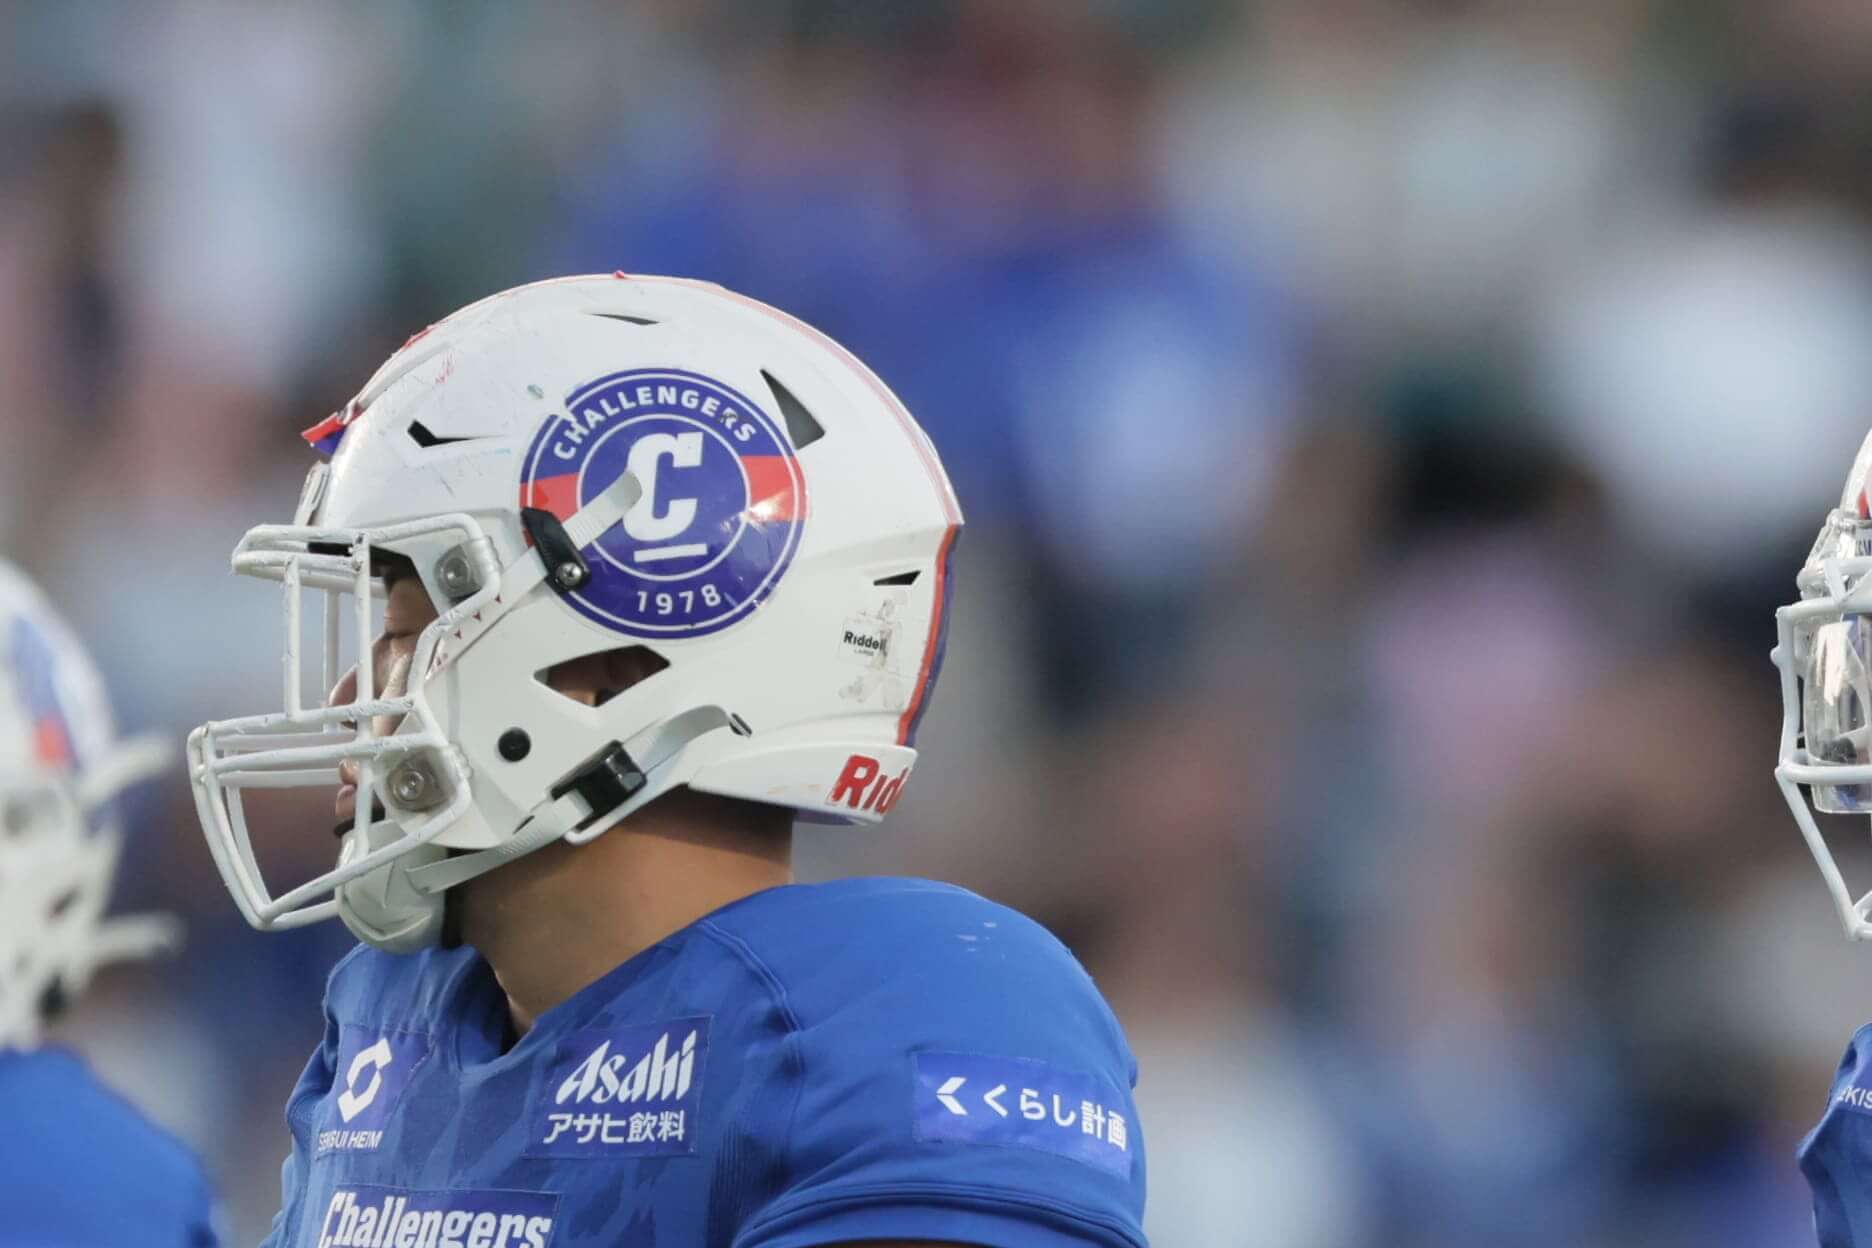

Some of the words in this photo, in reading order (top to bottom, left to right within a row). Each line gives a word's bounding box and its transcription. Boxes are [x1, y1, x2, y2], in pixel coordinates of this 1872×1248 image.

[553, 386, 757, 460] CHALLENGERS
[622, 431, 704, 541] C
[637, 584, 721, 615] 1978
[555, 1030, 697, 1105] Asahi
[347, 1130, 383, 1149] HEIM
[543, 1110, 685, 1144] アサヒ飲料
[983, 1083, 1127, 1151] くらし計画
